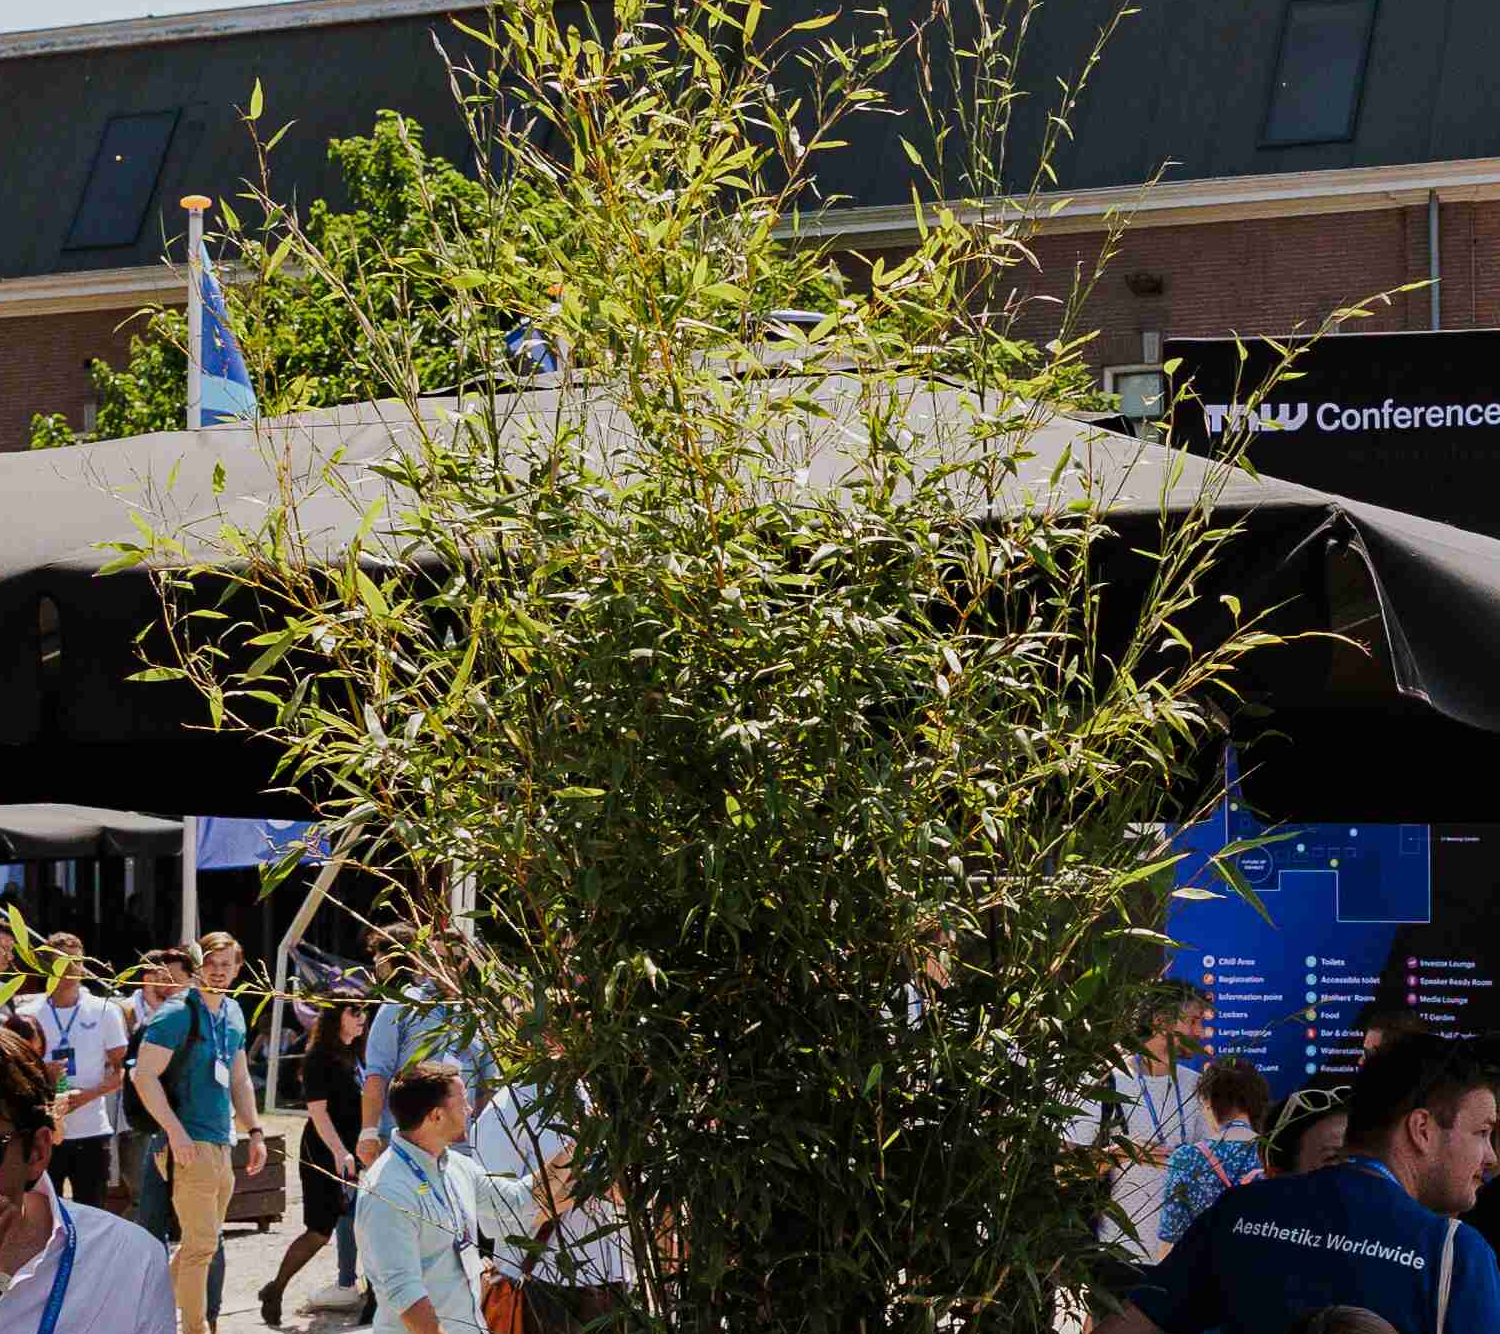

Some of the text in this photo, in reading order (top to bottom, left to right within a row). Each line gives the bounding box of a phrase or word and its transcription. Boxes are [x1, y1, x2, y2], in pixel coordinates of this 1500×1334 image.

[1321, 957, 1345, 966] Toilets
[1449, 959, 1475, 969] Lounge
[1218, 975, 1264, 985] Registration
[1321, 976, 1361, 985] Accessible
[1420, 977, 1492, 988] Speaker Ready Room
[1218, 993, 1262, 1002] Information
[1354, 993, 1376, 1002] Room
[1442, 996, 1468, 1006] Lounge
[1218, 1010, 1248, 1019] Lockers
[1321, 1011, 1340, 1019] Food
[1218, 1028, 1239, 1038] Large
[1321, 1028, 1364, 1038] Bar & drinks
[1232, 1216, 1425, 1272] Aesthetikz Worldwide
